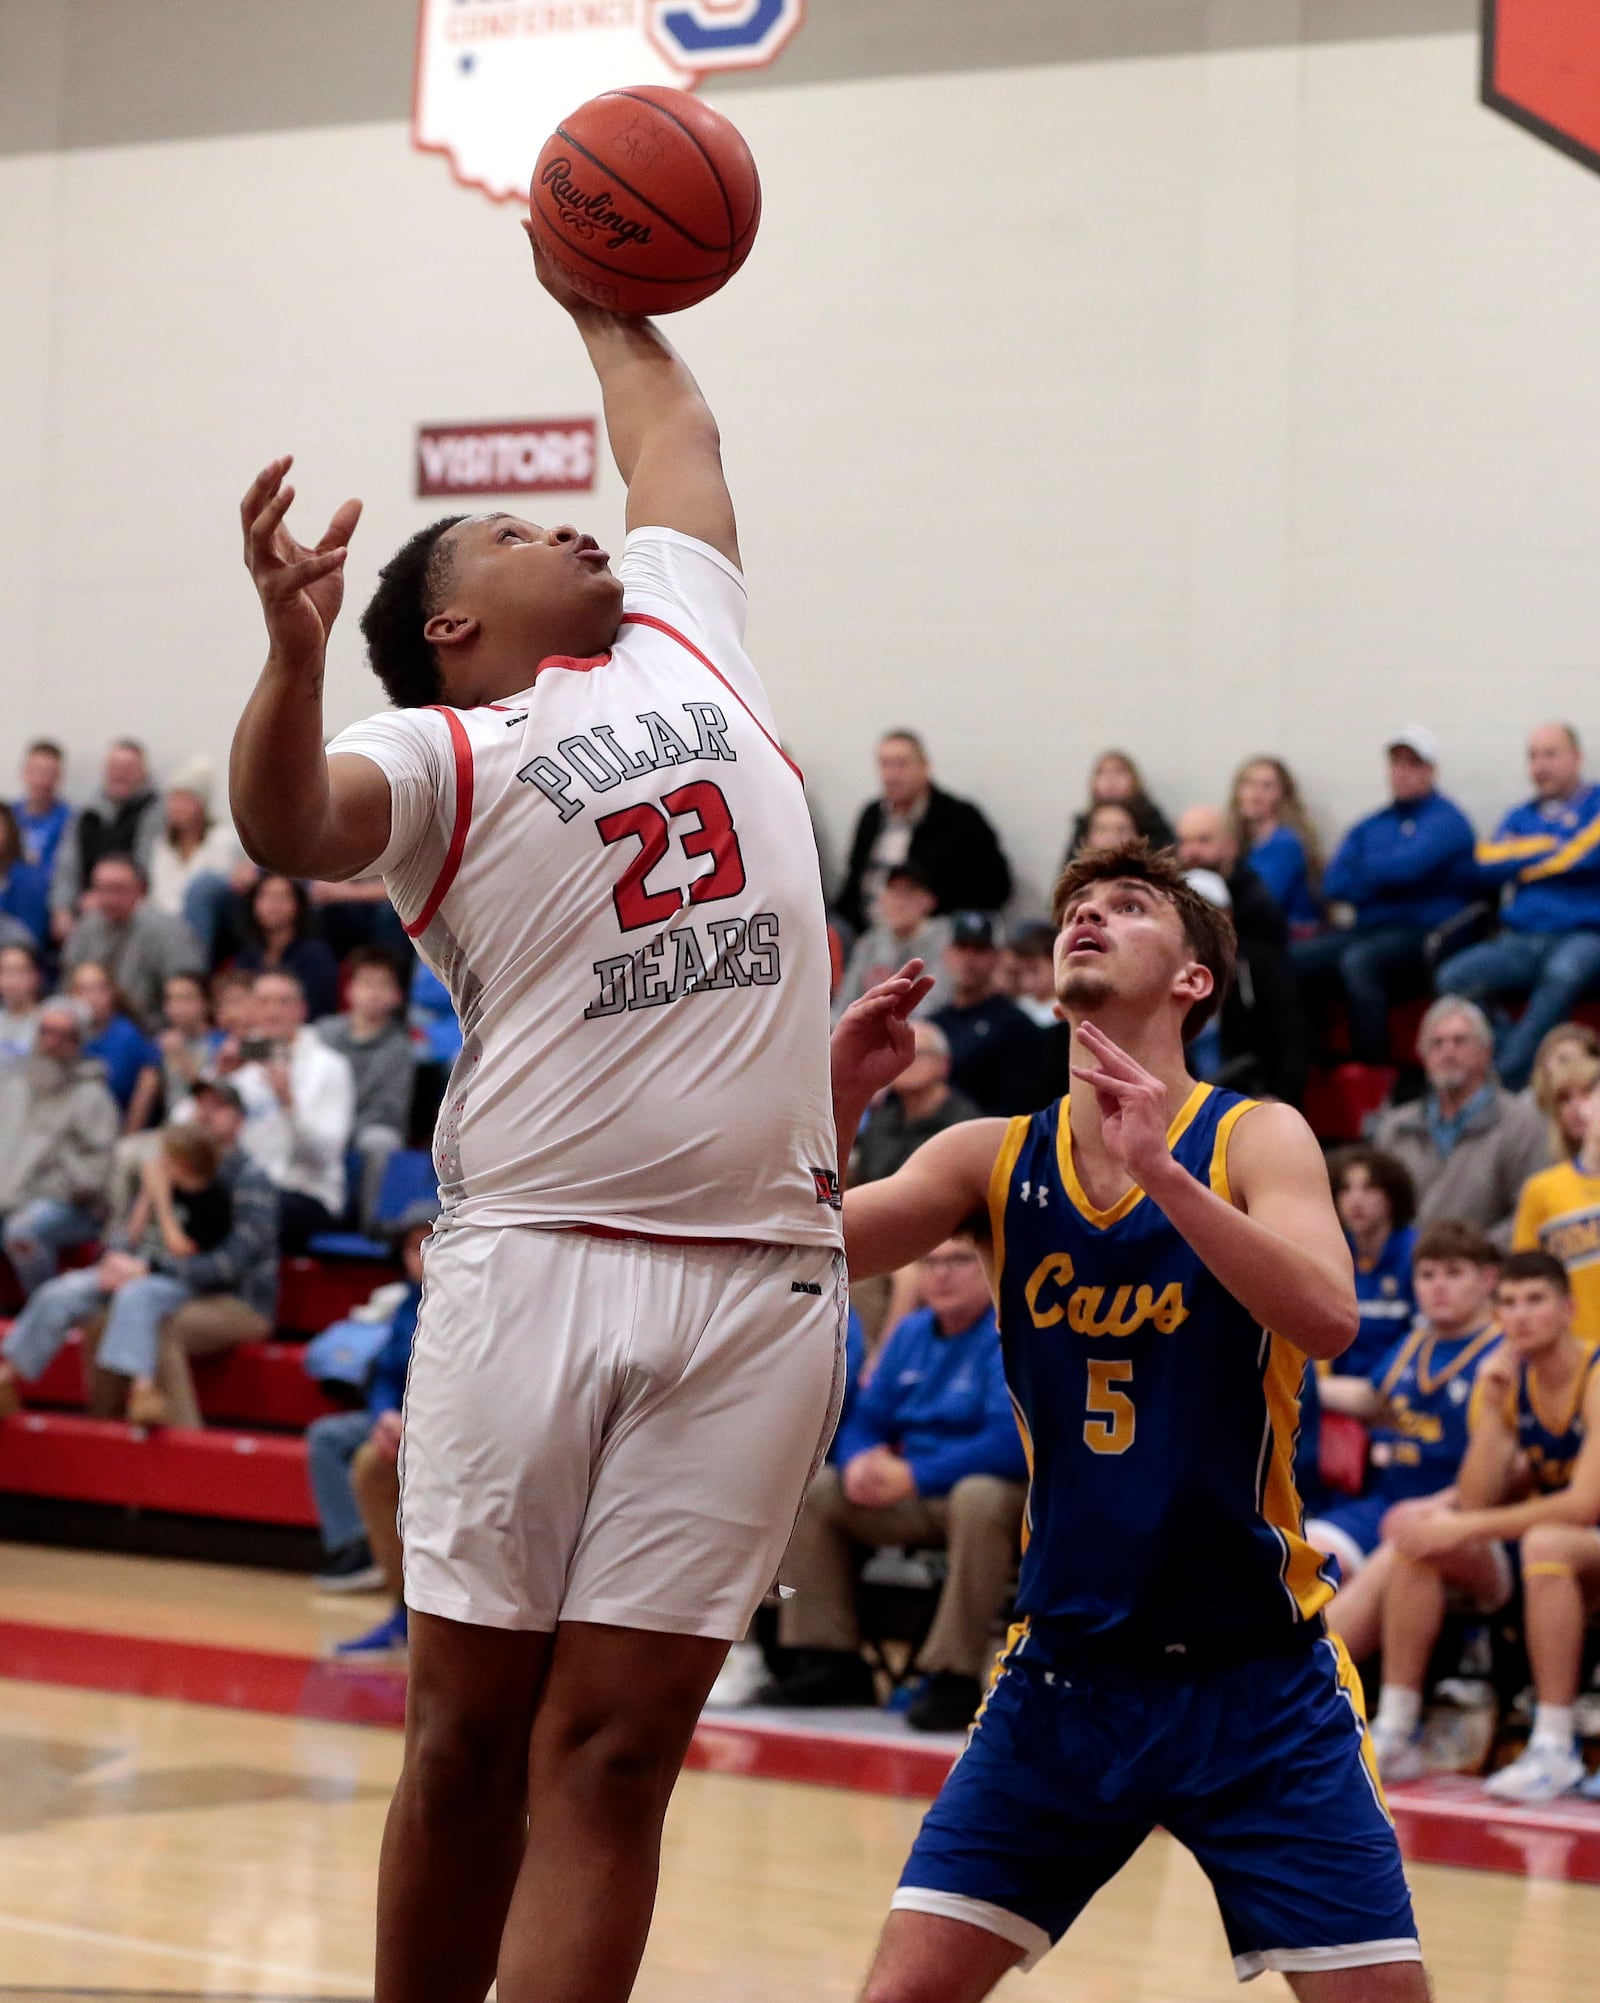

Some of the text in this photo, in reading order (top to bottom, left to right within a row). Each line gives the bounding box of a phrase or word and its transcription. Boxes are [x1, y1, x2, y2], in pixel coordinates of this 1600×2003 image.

[542, 157, 652, 249] Rawlings
[420, 431, 594, 486] VISITORS
[516, 702, 737, 823] POLAR
[594, 779, 746, 933] 23
[1025, 1252, 1190, 1338] Cavs
[1083, 1358, 1136, 1455] 5
